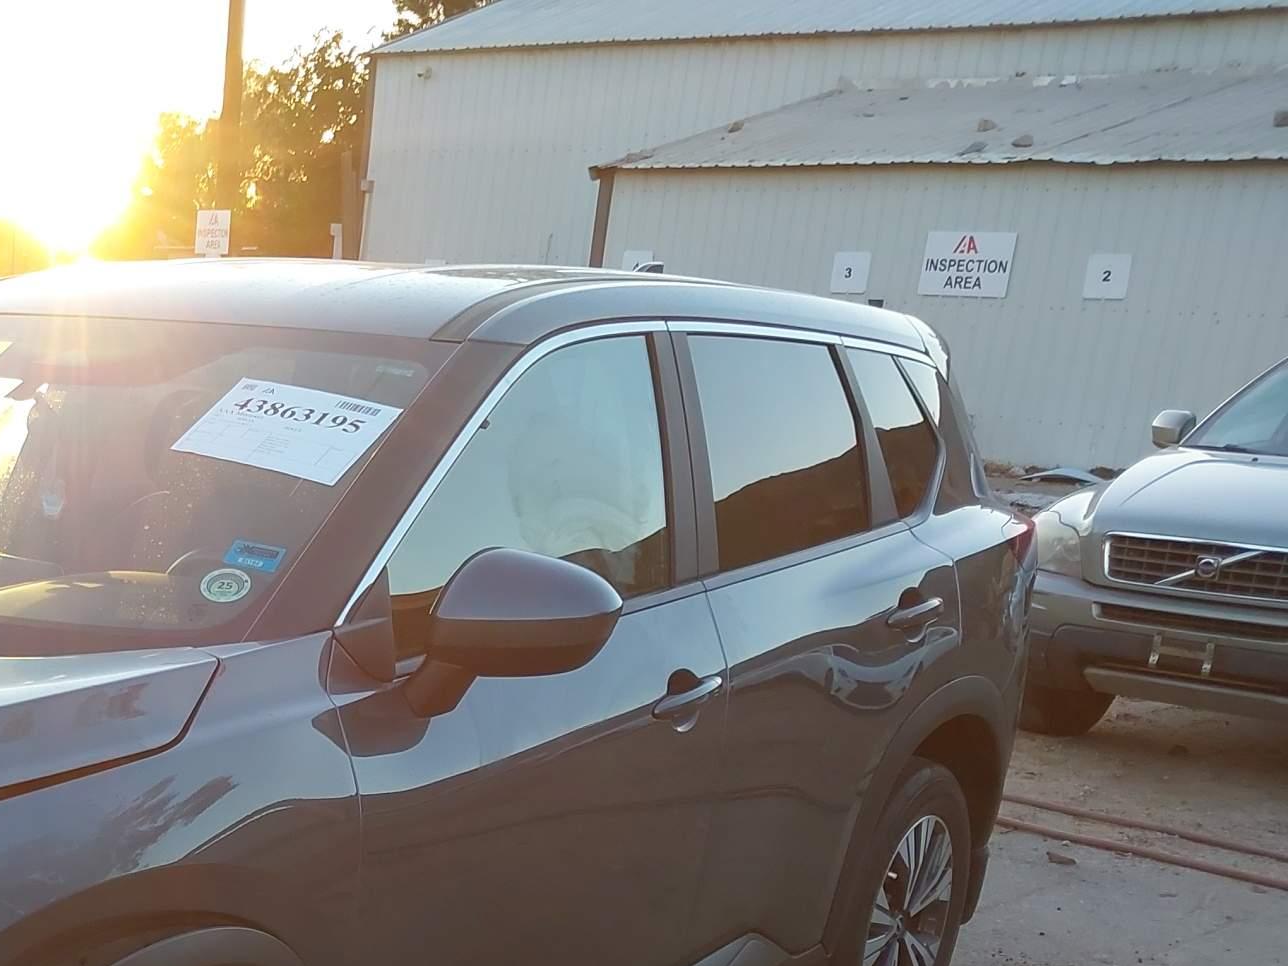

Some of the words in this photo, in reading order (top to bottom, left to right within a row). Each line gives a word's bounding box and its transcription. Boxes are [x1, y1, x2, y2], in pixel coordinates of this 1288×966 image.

[925, 258, 1008, 274] INSPECTION
[844, 267, 852, 279] 3
[1102, 270, 1111, 282] 2
[943, 275, 982, 290] AREA
[234, 398, 366, 434] 43863195
[217, 581, 233, 590] 25
